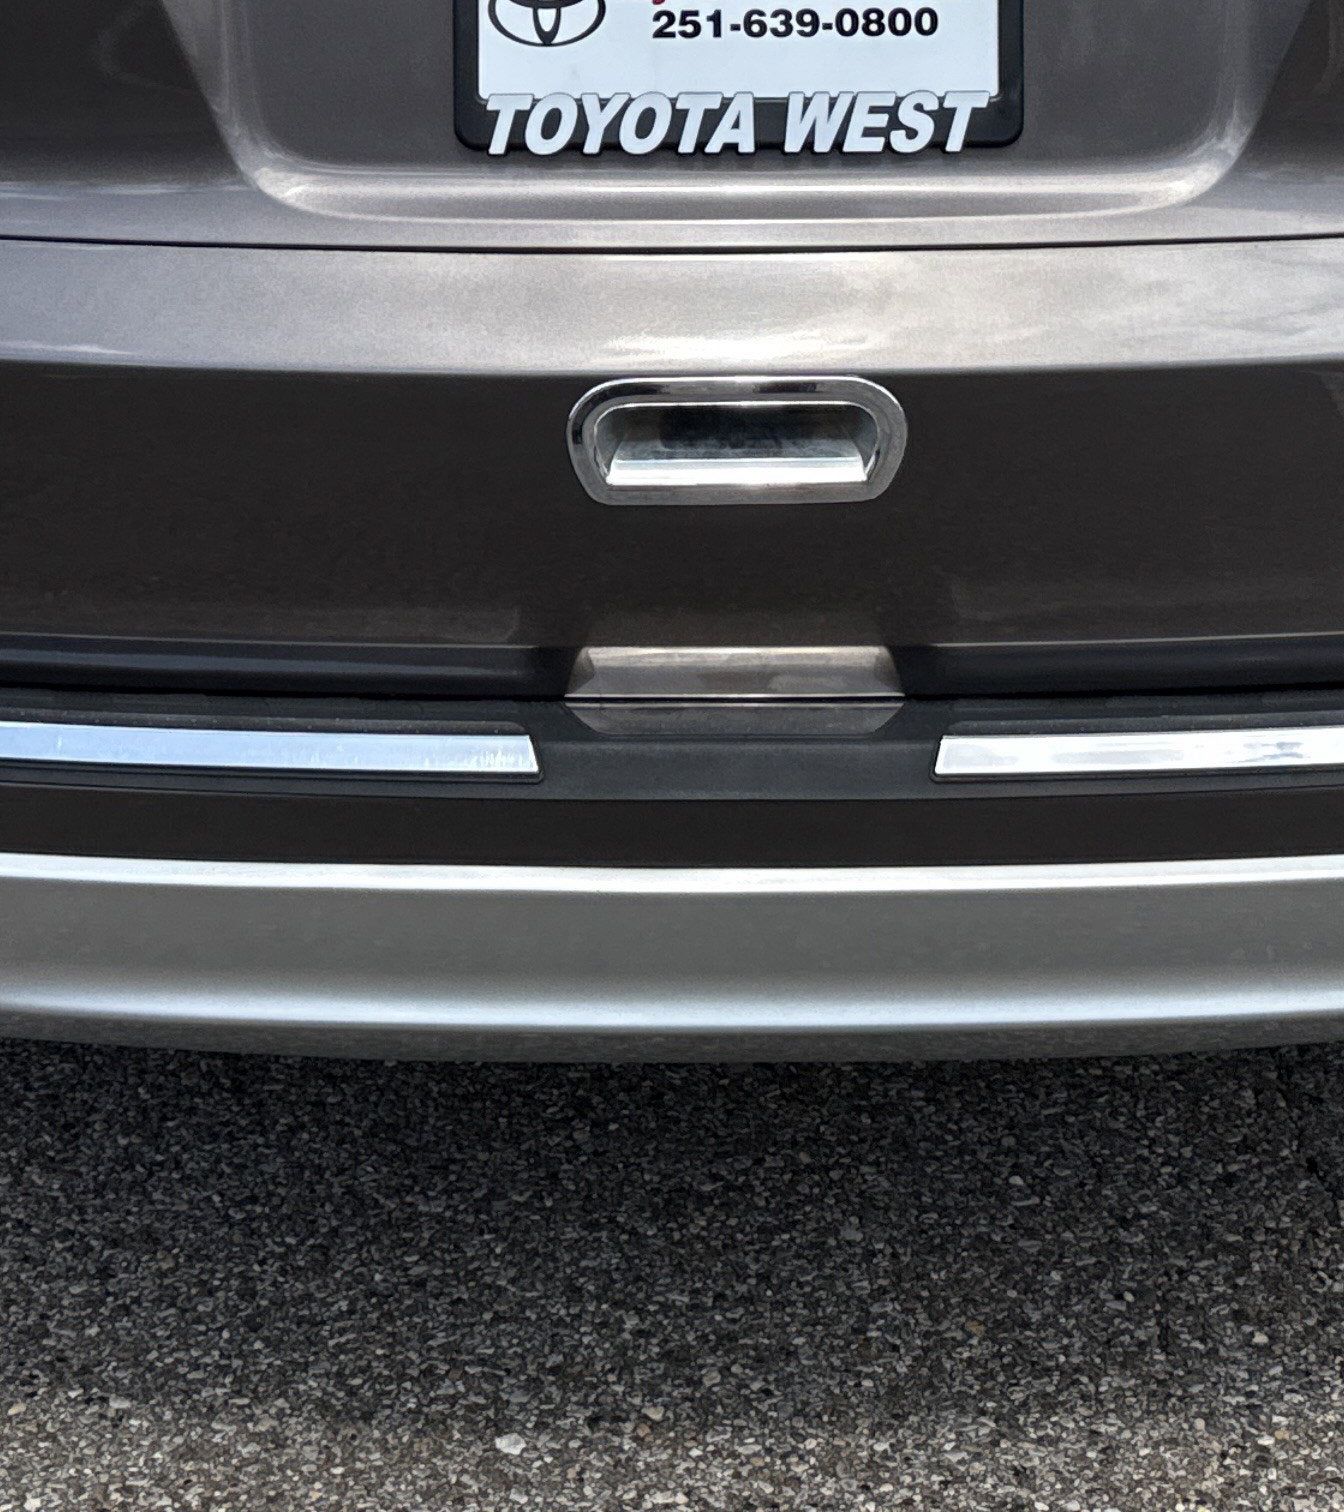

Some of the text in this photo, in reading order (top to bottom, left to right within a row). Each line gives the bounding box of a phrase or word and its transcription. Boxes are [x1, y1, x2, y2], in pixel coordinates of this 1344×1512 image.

[652, 7, 939, 40] 251-639-0800
[486, 90, 990, 156] TOYOTA WEST
